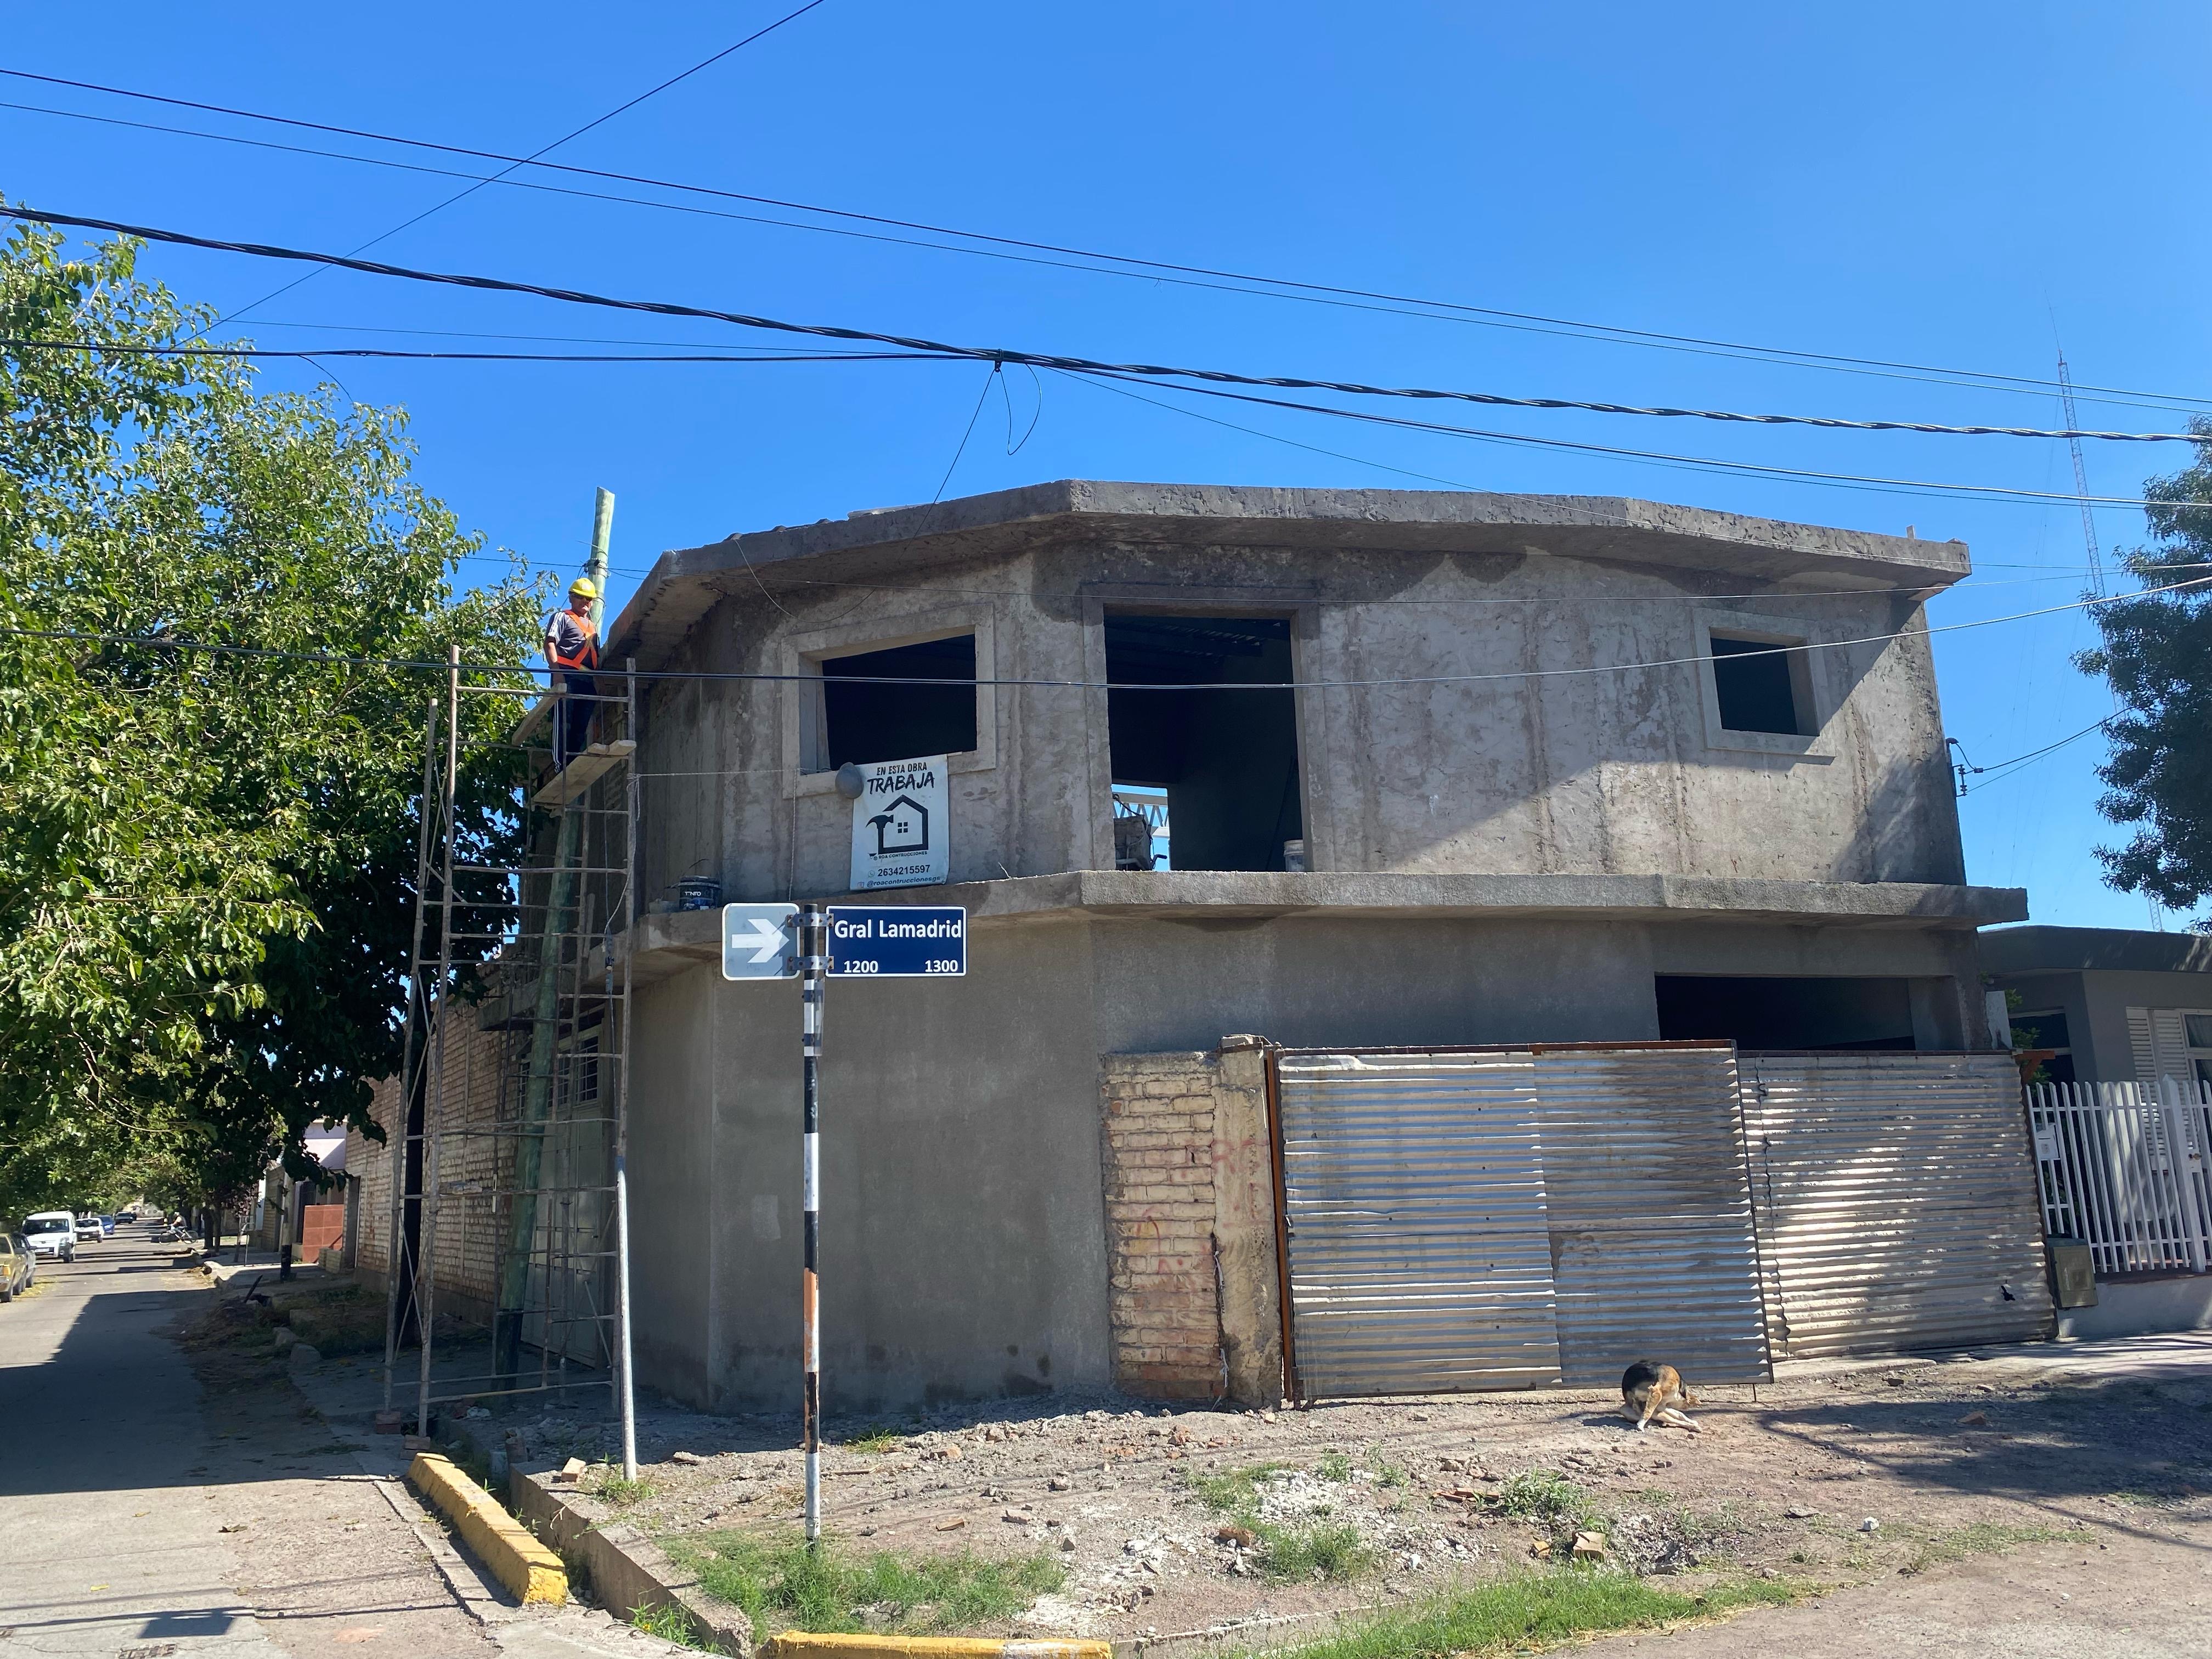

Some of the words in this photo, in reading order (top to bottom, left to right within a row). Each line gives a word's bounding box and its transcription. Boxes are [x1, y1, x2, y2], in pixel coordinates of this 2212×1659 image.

[876, 767, 886, 776] EN
[888, 765, 905, 775] ESTA
[907, 761, 927, 772] OBRA
[867, 771, 935, 795] TRABAJA
[877, 865, 930, 877] 2634215597
[834, 919, 872, 938] Gral
[879, 919, 962, 938] Lamadrid
[844, 961, 878, 973] 1200
[925, 960, 958, 973] 1300
